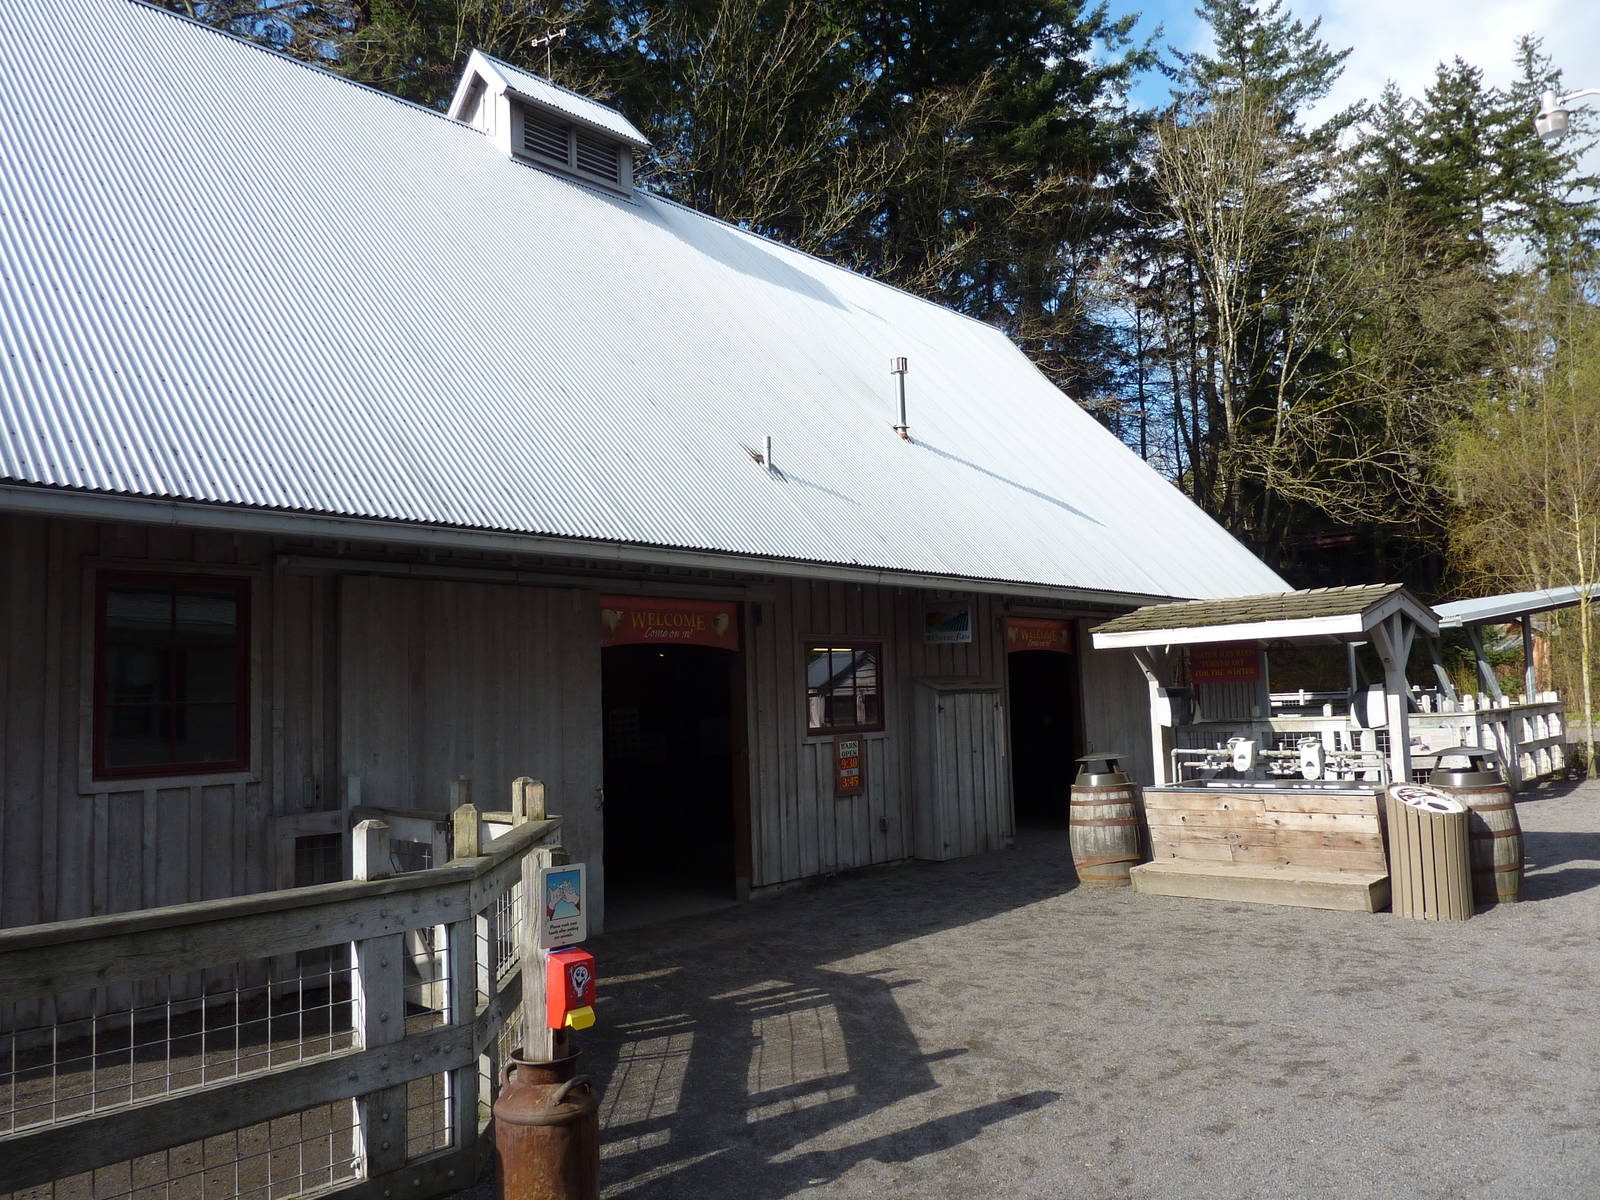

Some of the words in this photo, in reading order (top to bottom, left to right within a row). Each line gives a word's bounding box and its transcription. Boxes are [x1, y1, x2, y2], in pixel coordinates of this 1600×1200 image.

[631, 611, 705, 631] WELCOME
[644, 627, 667, 639] Come
[841, 742, 857, 750] BARN
[841, 758, 858, 769] 9:30
